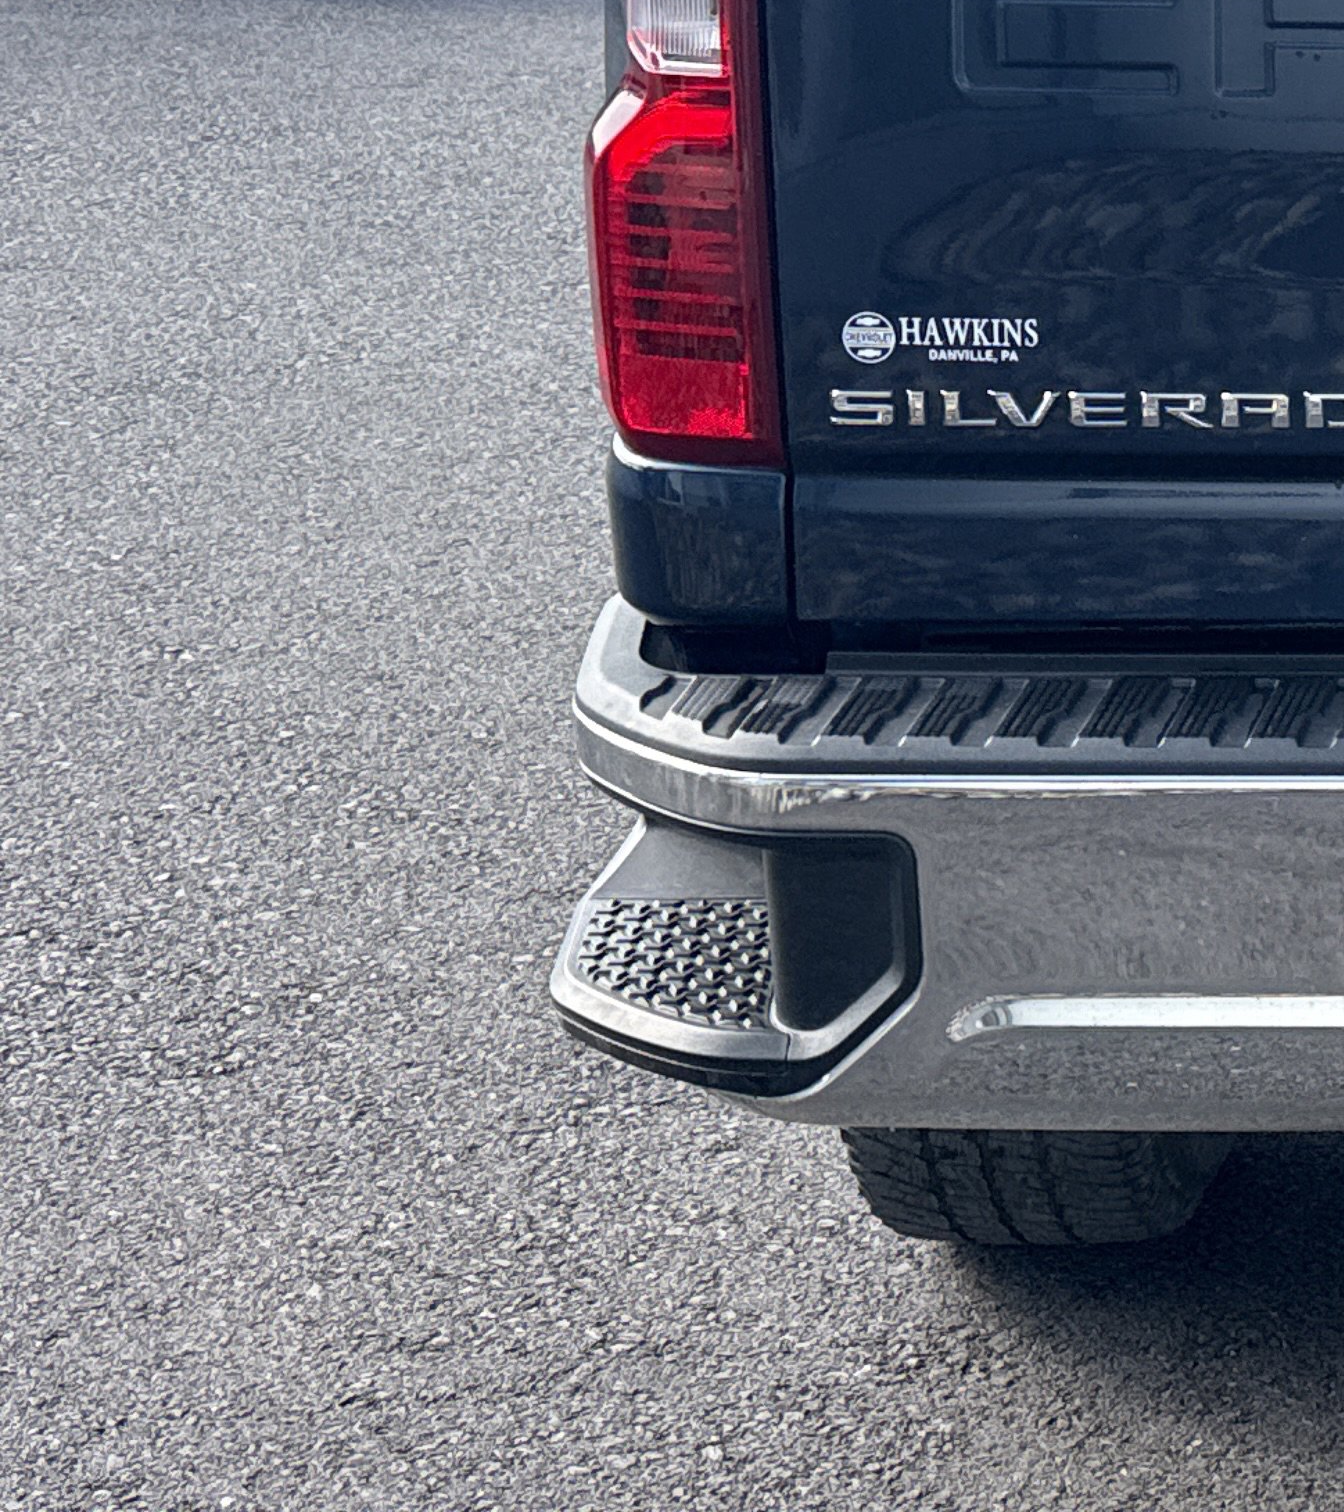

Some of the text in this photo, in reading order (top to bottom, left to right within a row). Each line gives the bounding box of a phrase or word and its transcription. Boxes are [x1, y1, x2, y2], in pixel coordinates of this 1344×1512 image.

[899, 317, 1039, 347] HAWKINS
[928, 348, 1019, 363] DANVILLE, PA
